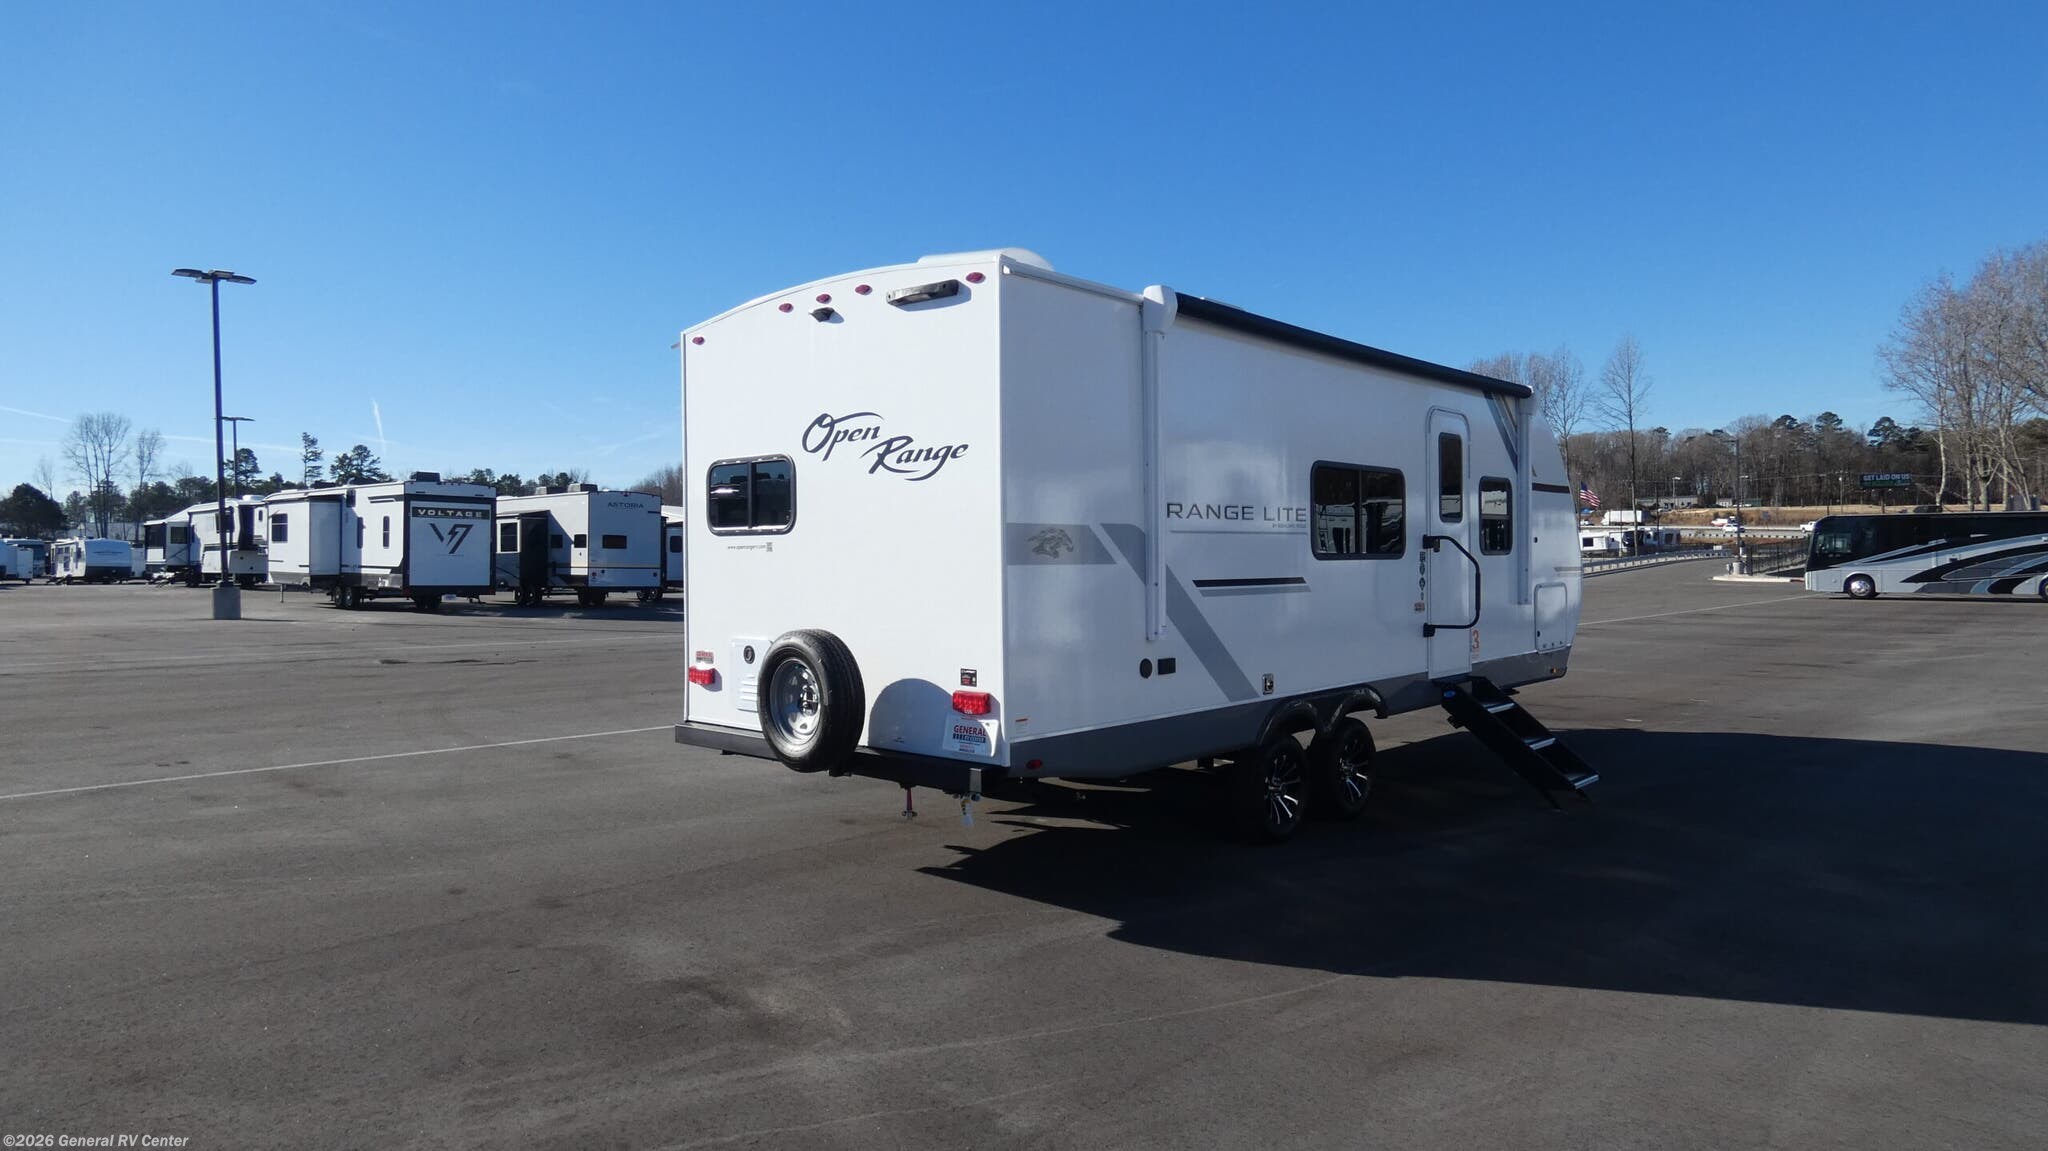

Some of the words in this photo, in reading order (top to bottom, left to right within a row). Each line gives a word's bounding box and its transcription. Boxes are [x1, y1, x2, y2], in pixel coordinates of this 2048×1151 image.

[802, 412, 885, 461] Open
[859, 435, 969, 482] Range
[607, 501, 644, 509] ASTORIA
[417, 508, 482, 518] VOLTAGE
[1166, 502, 1254, 521] RANGE
[1263, 506, 1307, 522] LITE
[953, 724, 987, 737] GENERAL
